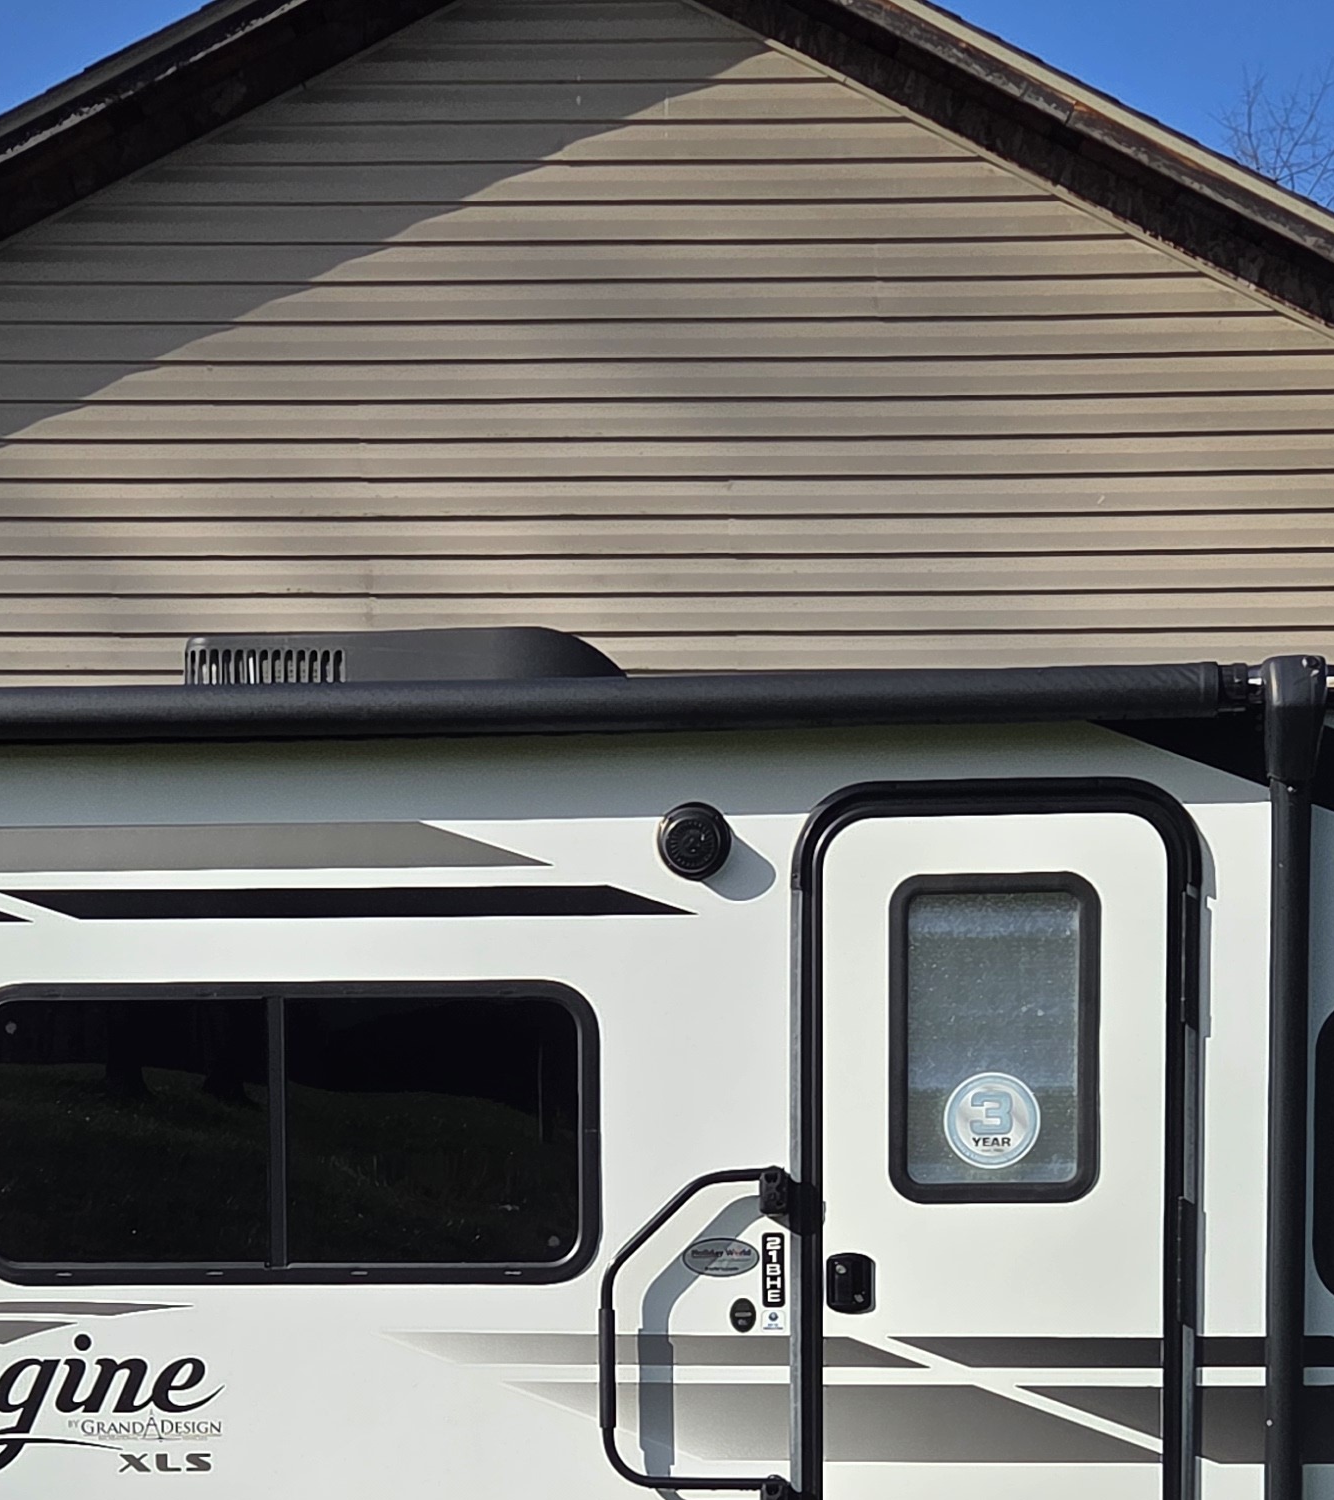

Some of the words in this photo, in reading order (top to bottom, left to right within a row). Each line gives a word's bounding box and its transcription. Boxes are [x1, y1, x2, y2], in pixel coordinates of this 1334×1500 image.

[969, 1091, 1014, 1136] 3
[972, 1137, 1012, 1147] YEAR
[765, 1236, 782, 1303] 21BHE
[68, 1420, 79, 1428] BY
[81, 1419, 144, 1435] GRAND
[161, 1419, 222, 1434] DESIGN
[119, 1453, 212, 1473] XLS
